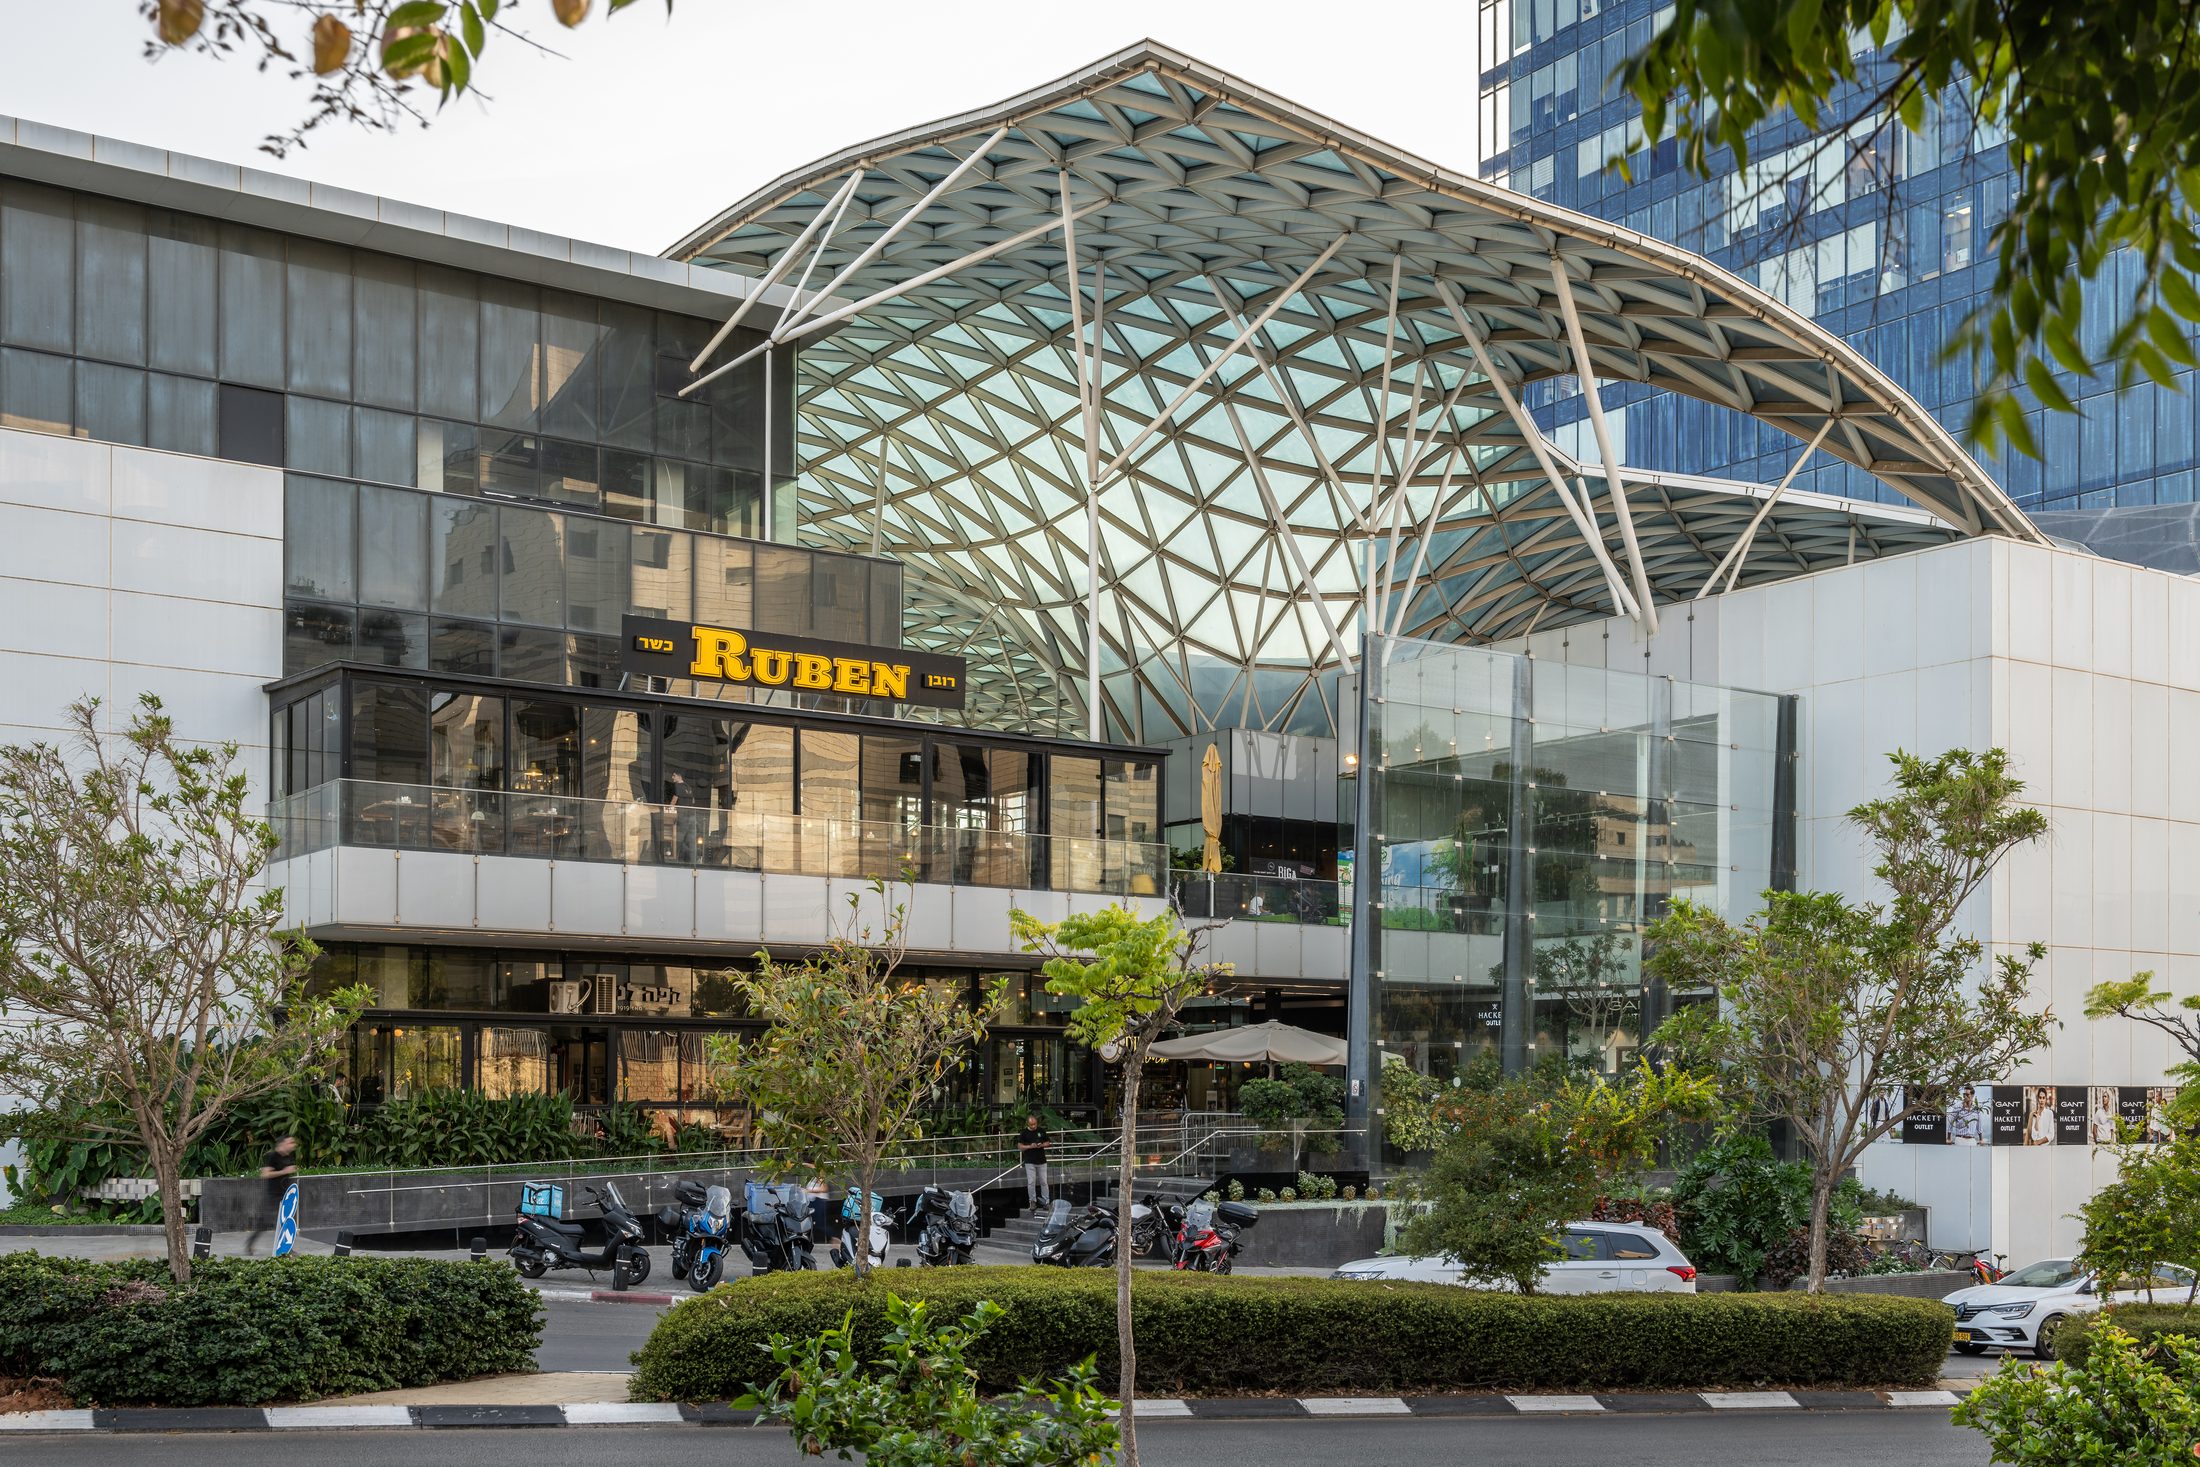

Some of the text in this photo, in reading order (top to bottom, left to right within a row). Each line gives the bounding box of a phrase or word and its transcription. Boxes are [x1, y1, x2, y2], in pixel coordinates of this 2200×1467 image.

[639, 637, 673, 651] כשר
[690, 626, 911, 699] RUBEN
[928, 674, 956, 688] רובן
[1906, 1114, 1941, 1122] HACKETT
